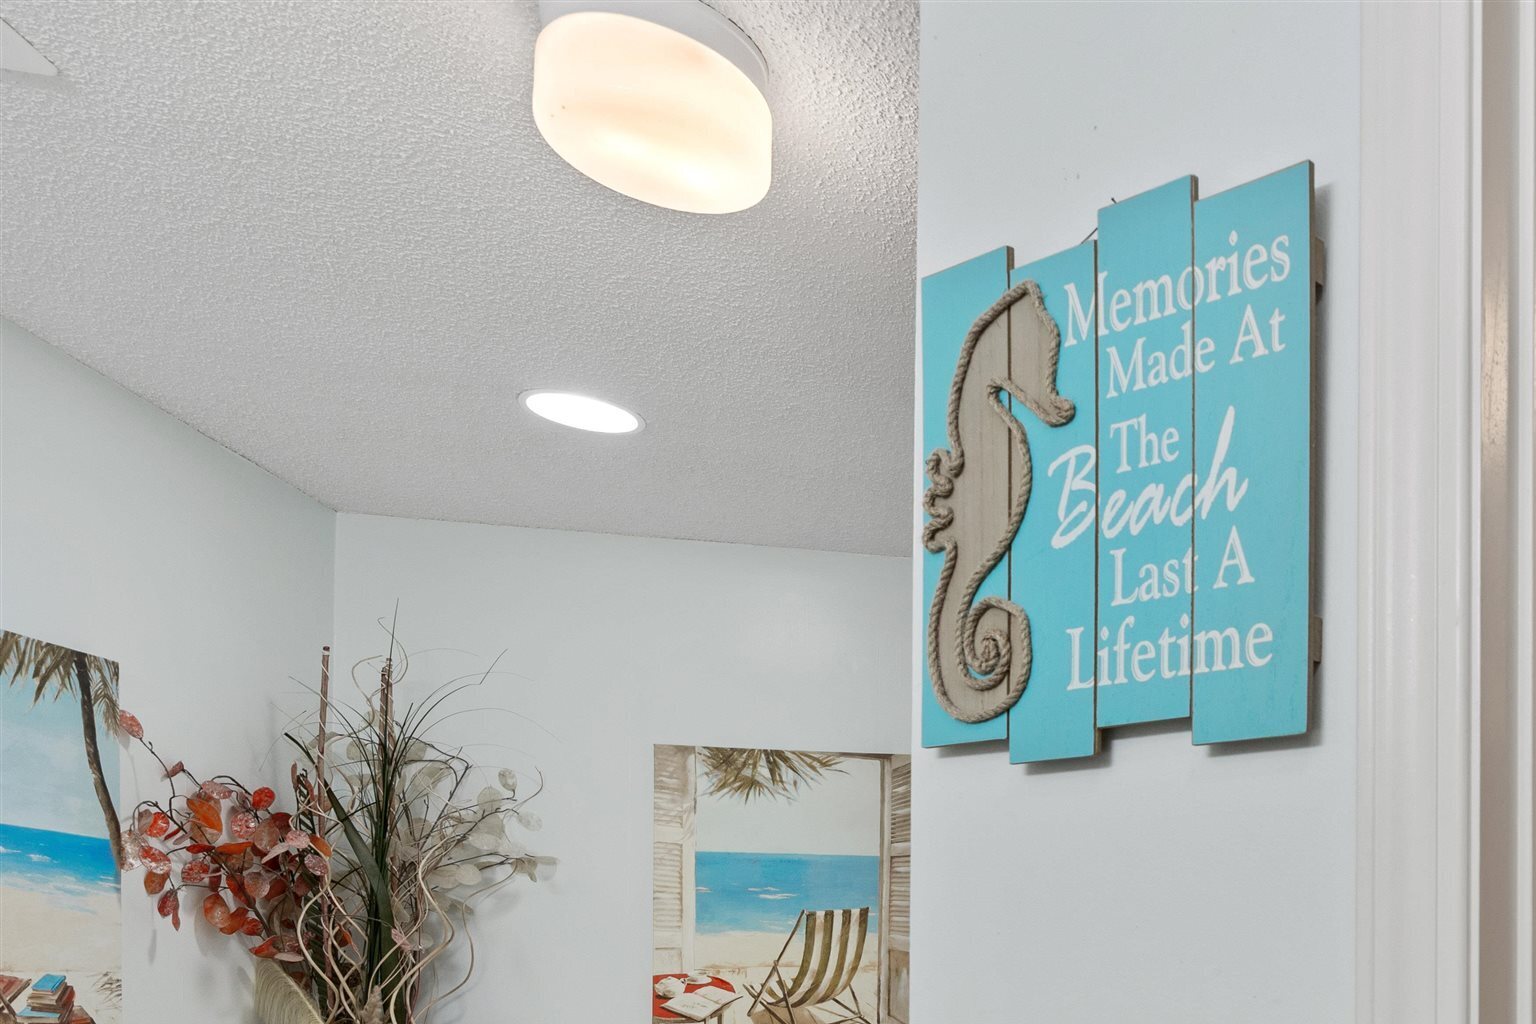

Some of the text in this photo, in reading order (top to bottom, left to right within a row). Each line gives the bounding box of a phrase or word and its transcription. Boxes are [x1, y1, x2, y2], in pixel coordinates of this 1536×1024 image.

[1063, 230, 1290, 347] Memories
[1106, 304, 1286, 399] Made At
[1048, 406, 1248, 550] Beach
[1110, 414, 1179, 473] The
[1110, 525, 1254, 606] Last A
[1066, 612, 1273, 691] Lifetime
